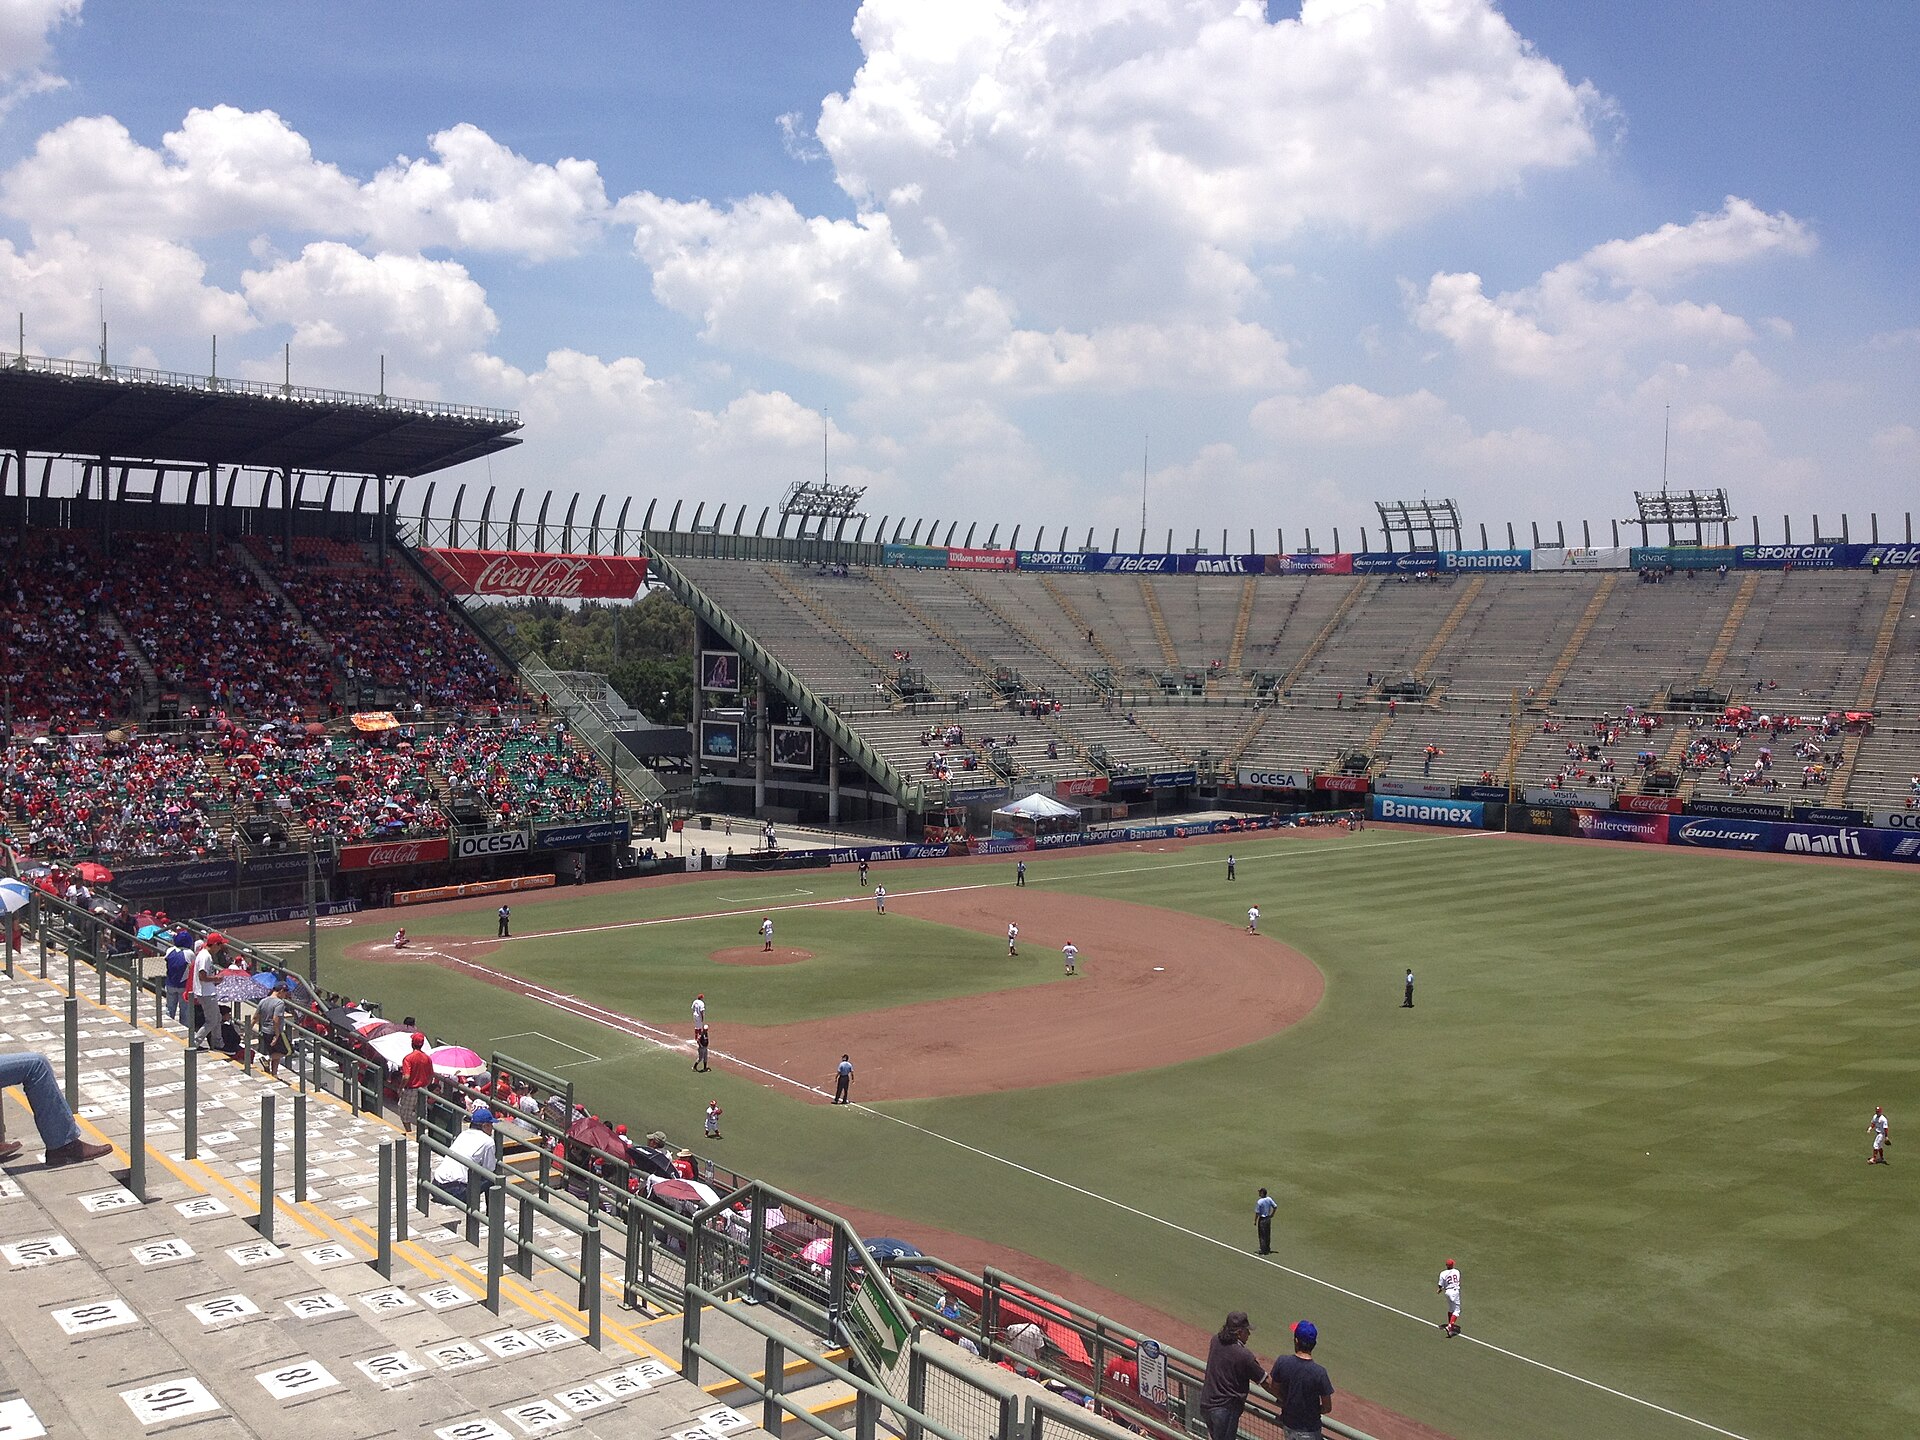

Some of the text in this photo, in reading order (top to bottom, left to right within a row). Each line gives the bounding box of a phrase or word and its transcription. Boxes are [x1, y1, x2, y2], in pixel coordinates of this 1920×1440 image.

[976, 555, 995, 563] MORE
[1031, 552, 1086, 564] SPORT CITY
[1446, 553, 1522, 567] Banamex
[1638, 553, 1666, 562] Kivac
[1757, 547, 1834, 559] SPORT CITY
[1120, 556, 1167, 571] telcel
[1290, 560, 1336, 570] Interceramic
[474, 556, 587, 598] Coca-Cola
[1070, 779, 1095, 793] Coca-Cola
[1250, 772, 1296, 787] OCESA
[1324, 777, 1357, 790] Coca-Cola
[1538, 798, 1596, 807] OCESA.COM.MX
[1630, 797, 1668, 811] Coca-Cola
[1382, 800, 1473, 824] Banamex
[1530, 810, 1546, 818] 326
[1693, 804, 1781, 816] VISITA OCESA.COM.MX
[1130, 828, 1167, 839] Banamex
[1593, 819, 1656, 835] Interceramic
[1043, 833, 1080, 844] SPORT CITY
[1090, 829, 1126, 840] SPORT CITY
[1685, 828, 1760, 842] BUD LIGHT
[463, 834, 526, 854] OCESA
[989, 842, 1029, 853] Interceramic
[368, 844, 421, 865] Coca-Cola
[918, 846, 948, 857] telcel
[249, 863, 273, 871] VISITA
[144, 875, 171, 884] LIGHT
[182, 869, 230, 880] BUD LIGHT
[458, 887, 465, 895] G
[511, 880, 518, 889] G
[91, 1193, 126, 1208] 24
[185, 1201, 217, 1213] 26
[15, 1242, 58, 1261] 20
[145, 1243, 183, 1260] 22
[237, 1246, 271, 1260] 24
[312, 1247, 343, 1261] 26
[1447, 1274, 1458, 1284] 28
[371, 1293, 405, 1308] 24
[429, 1289, 460, 1304] 26
[863, 1282, 880, 1311] RUTA DE
[204, 1299, 244, 1317] 20
[298, 1296, 334, 1313] 22
[71, 1305, 117, 1325] 18
[494, 1335, 525, 1351] 24
[536, 1329, 566, 1343] 26
[438, 1347, 476, 1364] 22
[368, 1356, 409, 1374] 20
[634, 1363, 663, 1379] 26
[275, 1368, 319, 1388] 18
[143, 1388, 194, 1411] 16
[567, 1389, 601, 1406] 22
[518, 1405, 557, 1424] 20
[710, 1411, 739, 1426] 24
